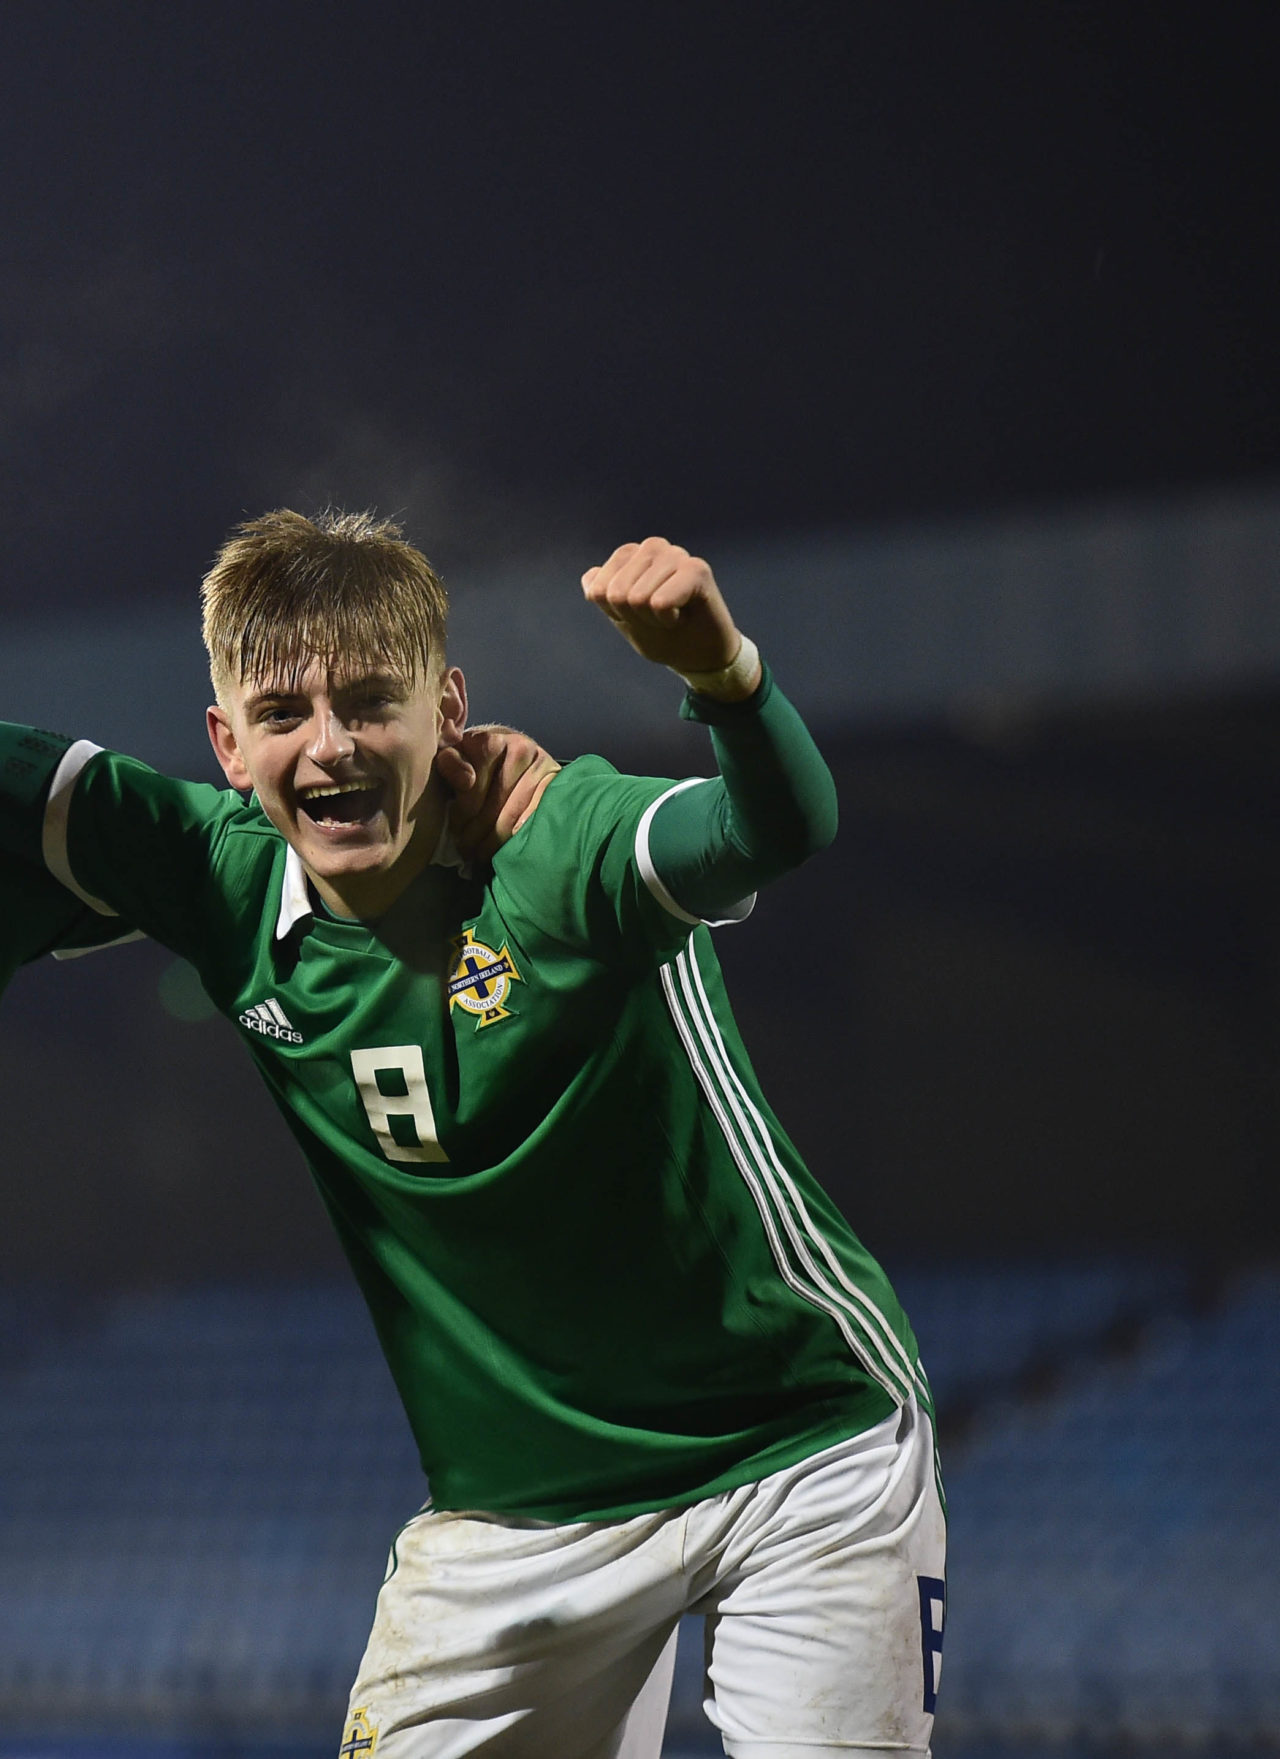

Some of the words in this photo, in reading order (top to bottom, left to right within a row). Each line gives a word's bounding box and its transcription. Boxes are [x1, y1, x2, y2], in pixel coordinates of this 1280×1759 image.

[464, 983, 504, 1009] ASSOCIATION
[238, 1015, 303, 1044] adidas
[350, 1045, 450, 1163] 8
